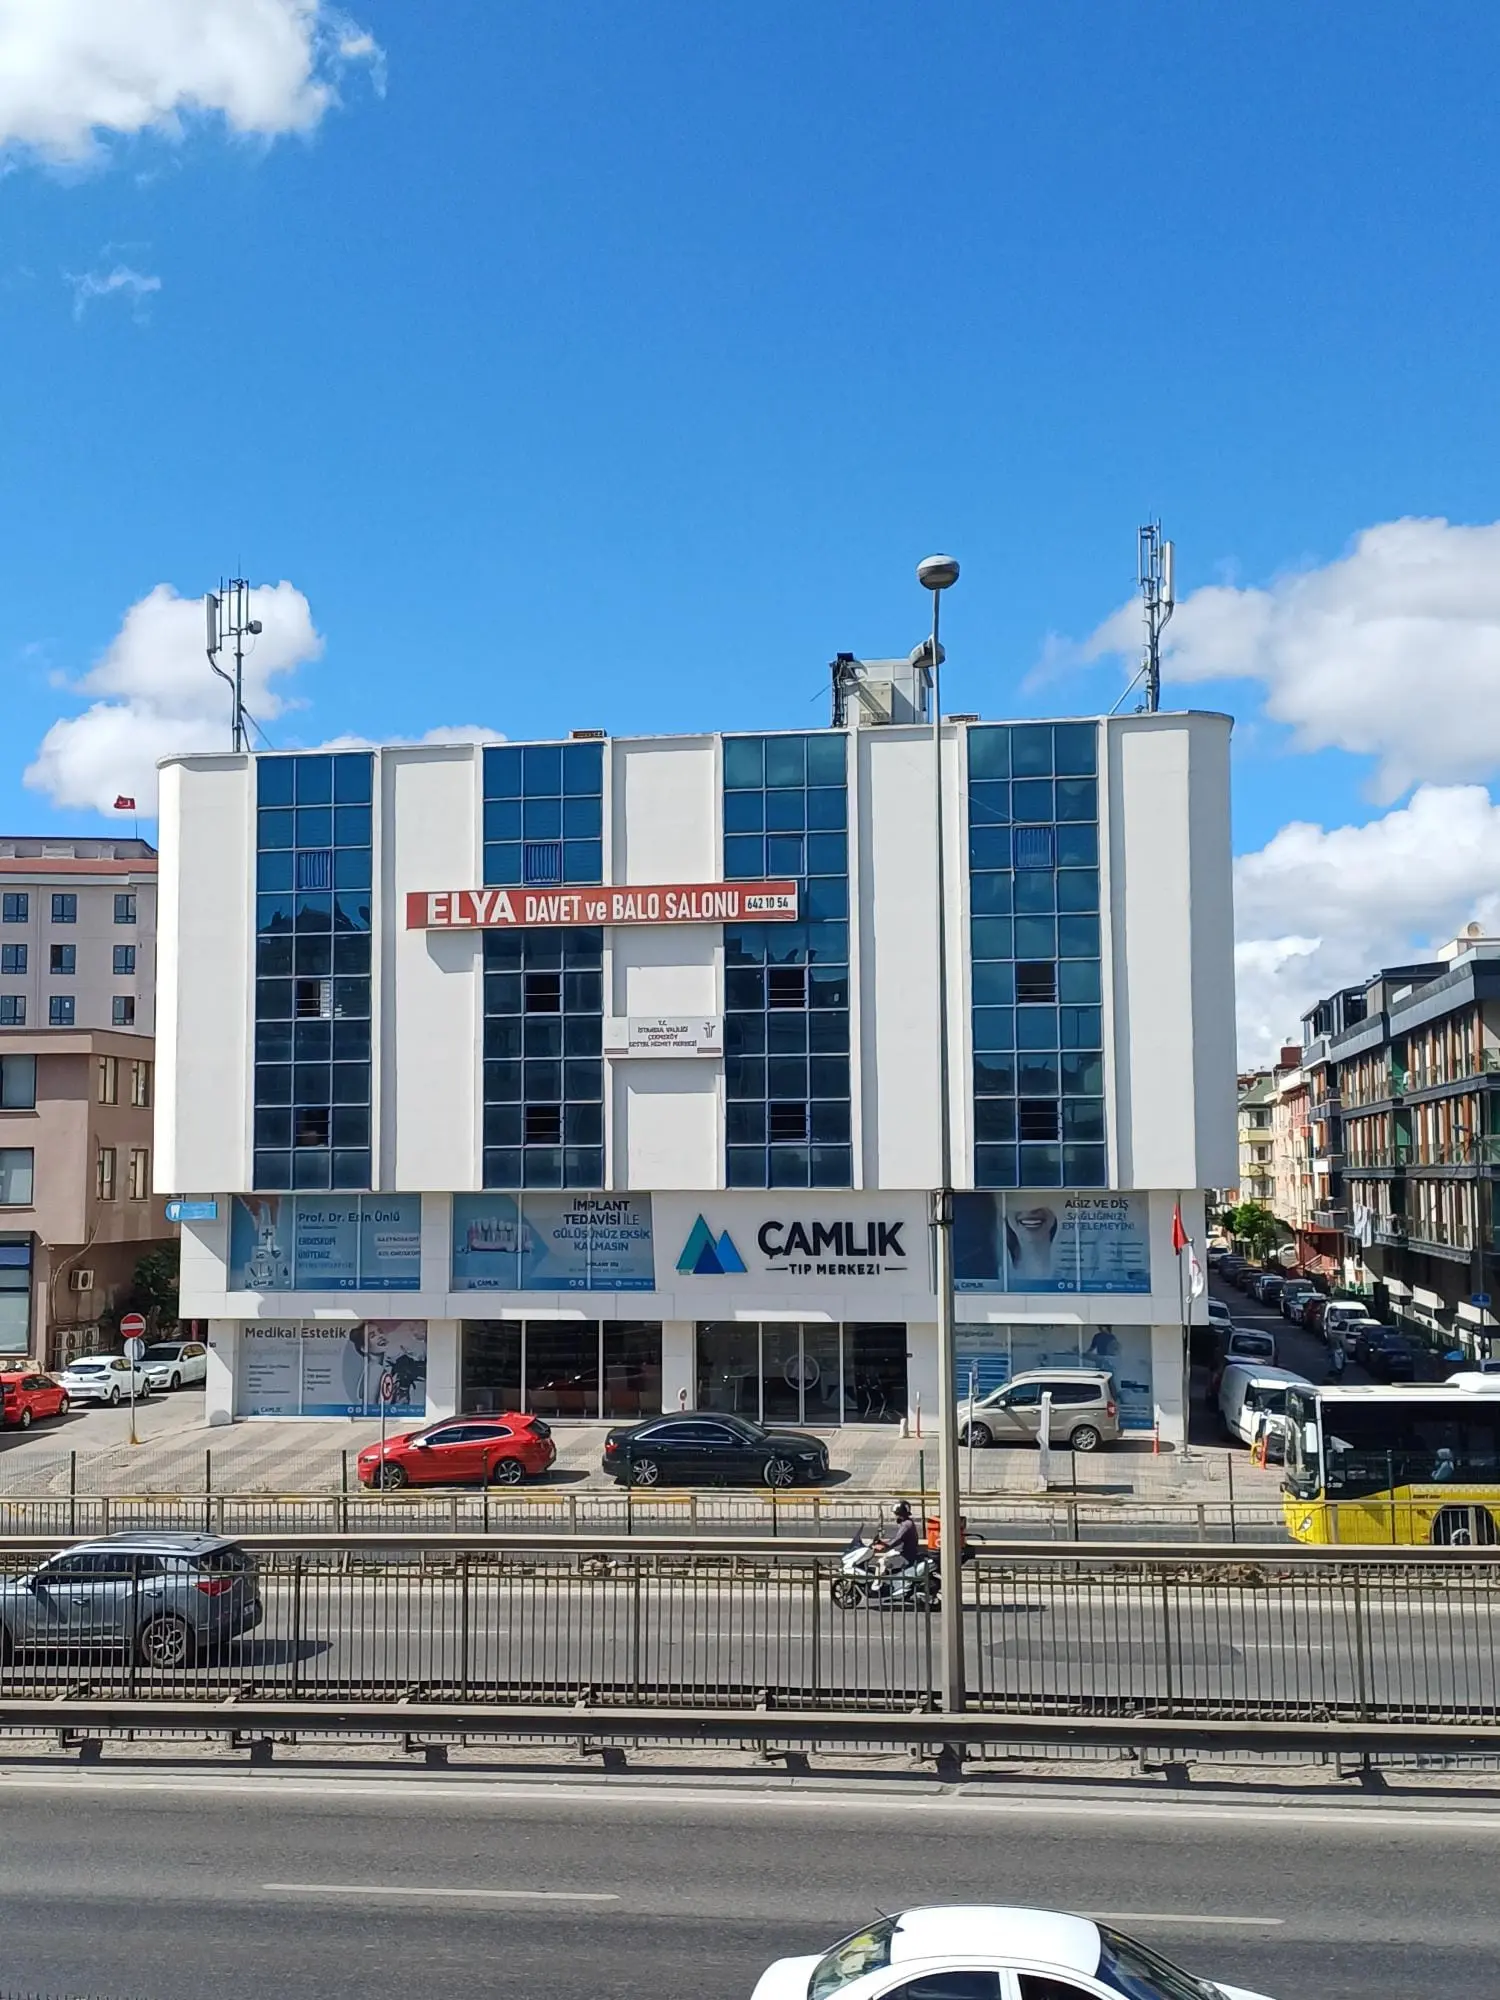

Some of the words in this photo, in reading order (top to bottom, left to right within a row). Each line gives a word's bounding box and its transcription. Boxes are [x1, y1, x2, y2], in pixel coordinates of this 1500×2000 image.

[427, 890, 517, 925] ELYA
[525, 895, 582, 922] DAVET
[585, 901, 607, 921] ve
[612, 893, 660, 920] BALO
[665, 890, 739, 920] SALONU
[747, 897, 764, 909] 642
[766, 897, 774, 908] 10
[777, 896, 789, 908] 54
[573, 1198, 630, 1211] İMPLANT
[1064, 1197, 1091, 1209] AĞIZ
[1093, 1199, 1109, 1209] VE
[1110, 1197, 1129, 1211] DİŞ
[298, 1212, 325, 1223] Prof.
[328, 1212, 345, 1223] Dr.
[374, 1210, 400, 1223] Ünlü
[563, 1211, 621, 1225] TEDAVİSİ
[623, 1212, 640, 1226] İLE
[620, 1227, 651, 1240] EKSİK
[757, 1220, 907, 1260] ÇAMLIK
[574, 1241, 629, 1251] KALMASIN
[788, 1263, 812, 1275] TIP
[244, 1326, 296, 1340] Medikal
[301, 1326, 347, 1339] Estetik
